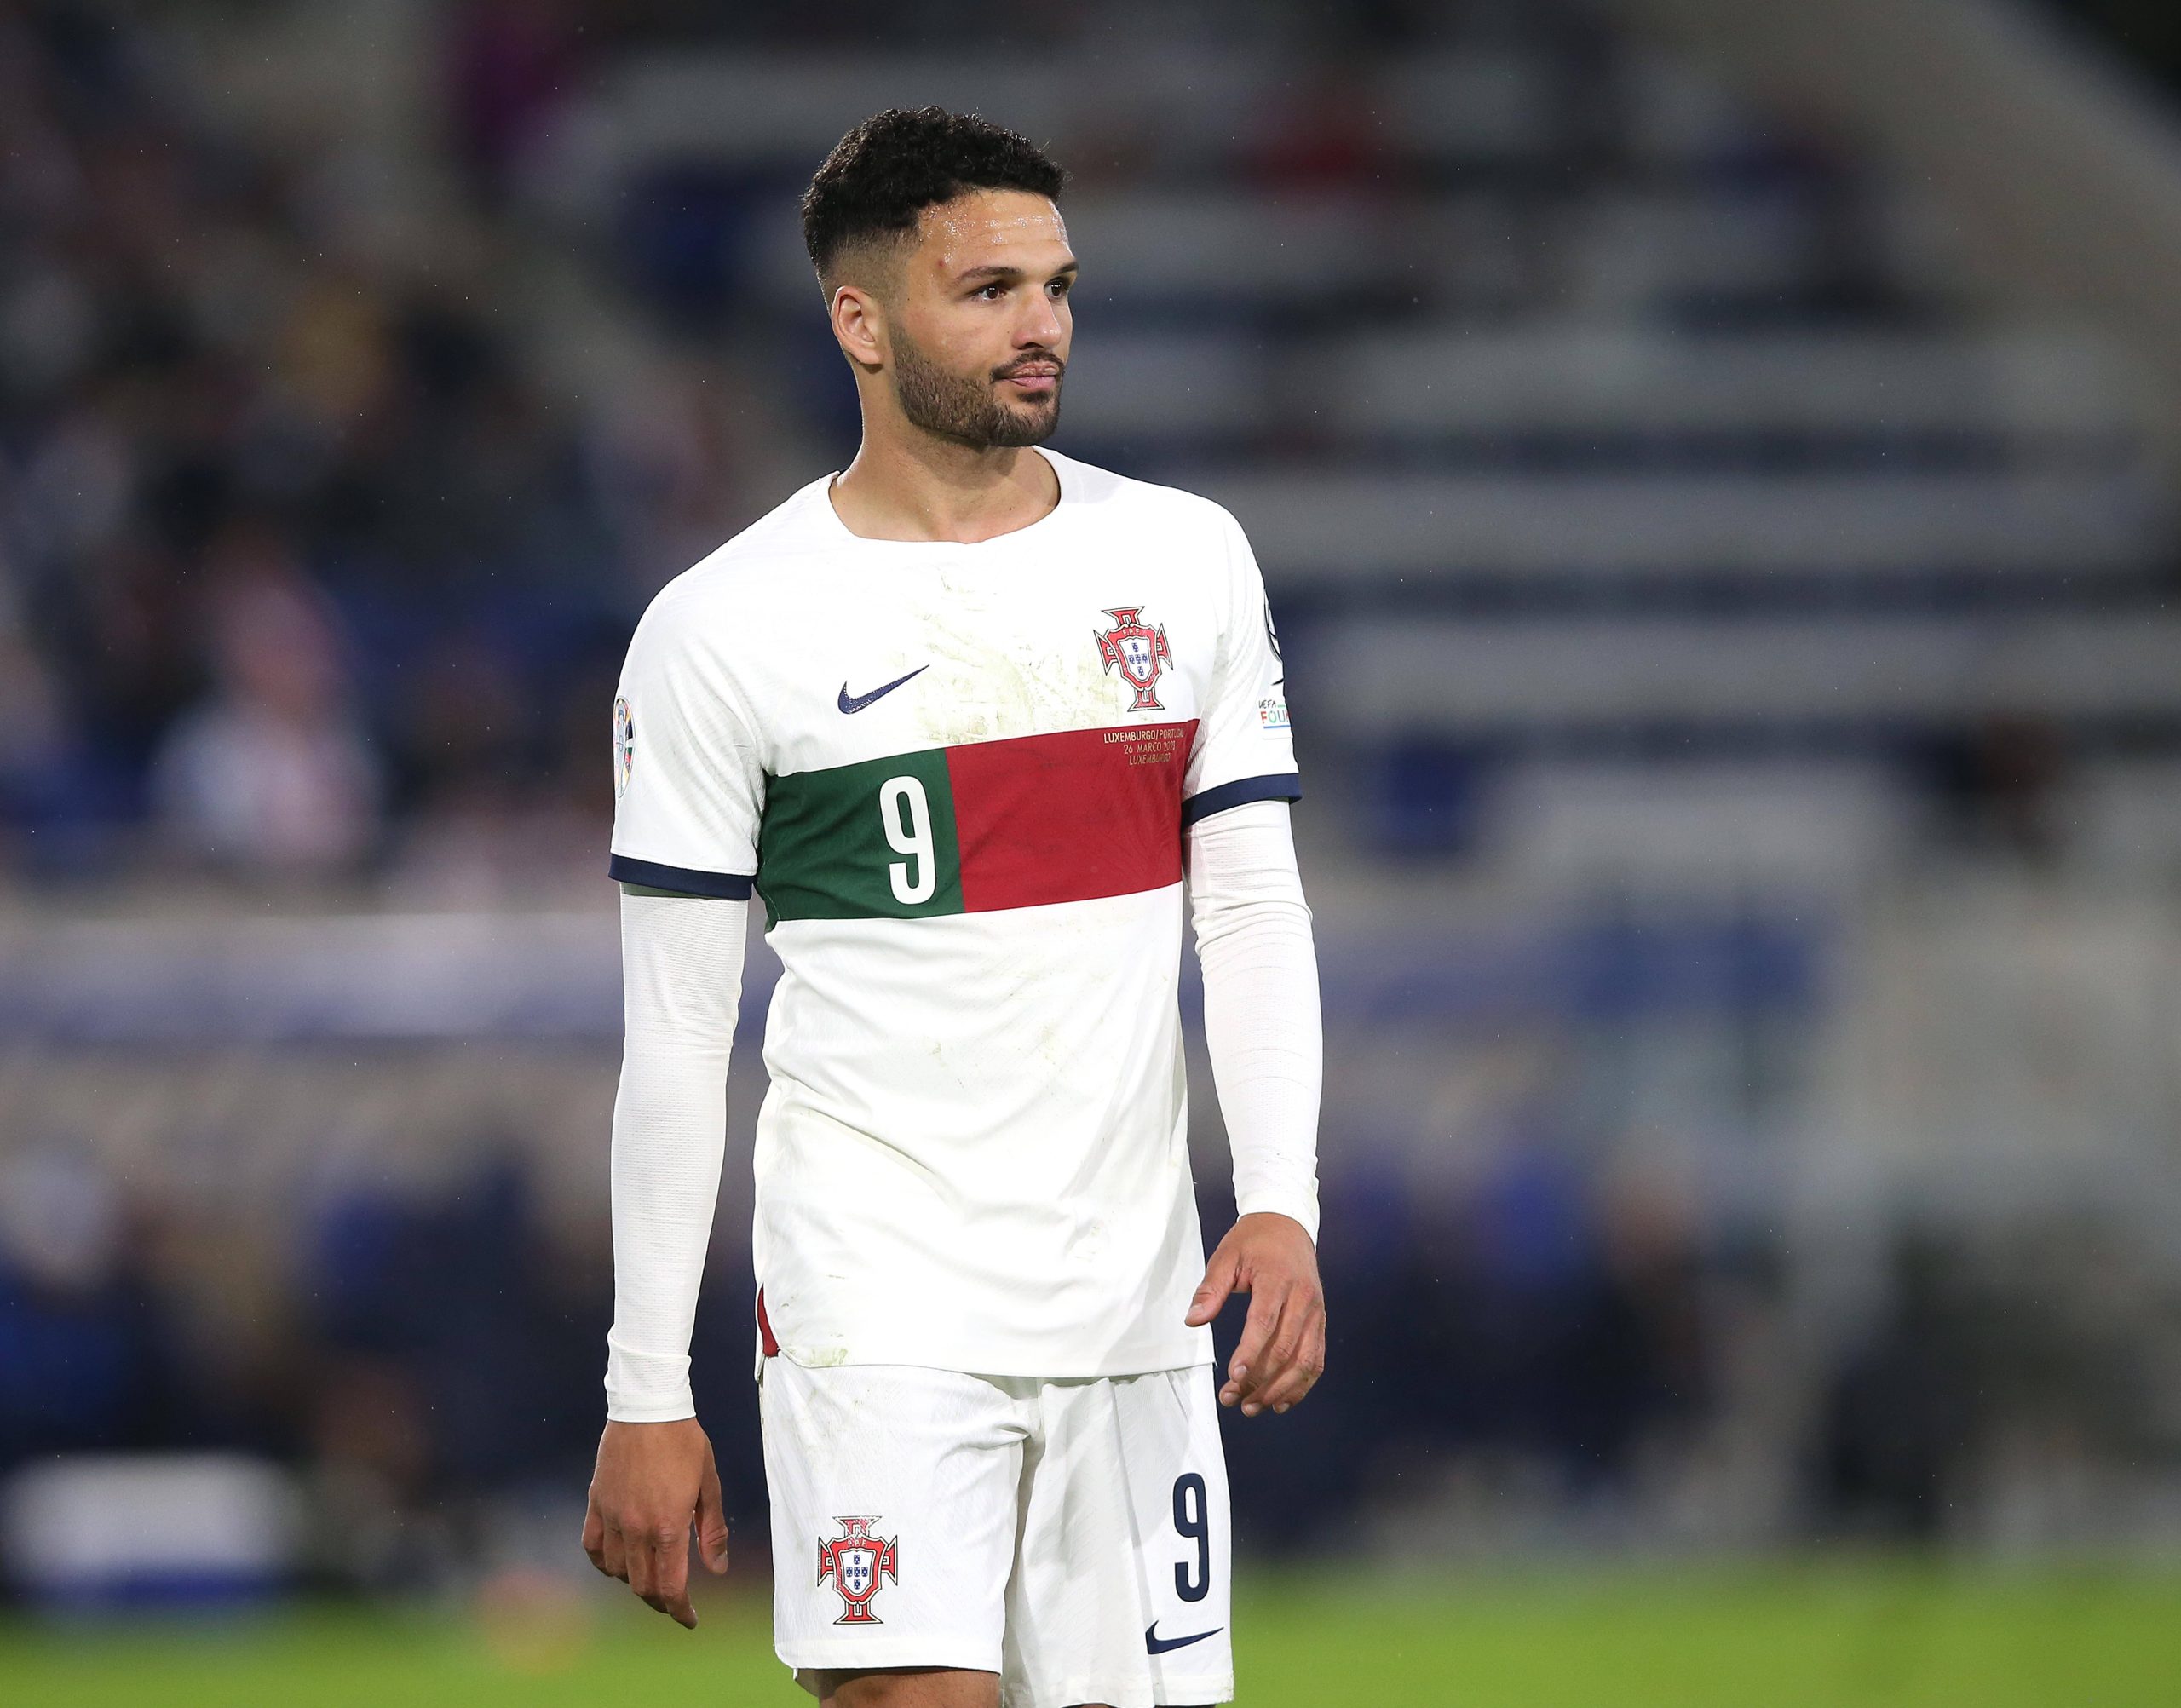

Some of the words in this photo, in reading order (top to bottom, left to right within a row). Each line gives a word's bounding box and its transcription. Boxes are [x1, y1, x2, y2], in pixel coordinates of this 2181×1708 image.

[1258, 699, 1276, 709] UEFA
[1124, 744, 1133, 754] 26
[879, 775, 937, 905] 9
[1172, 1472, 1210, 1602] 9
